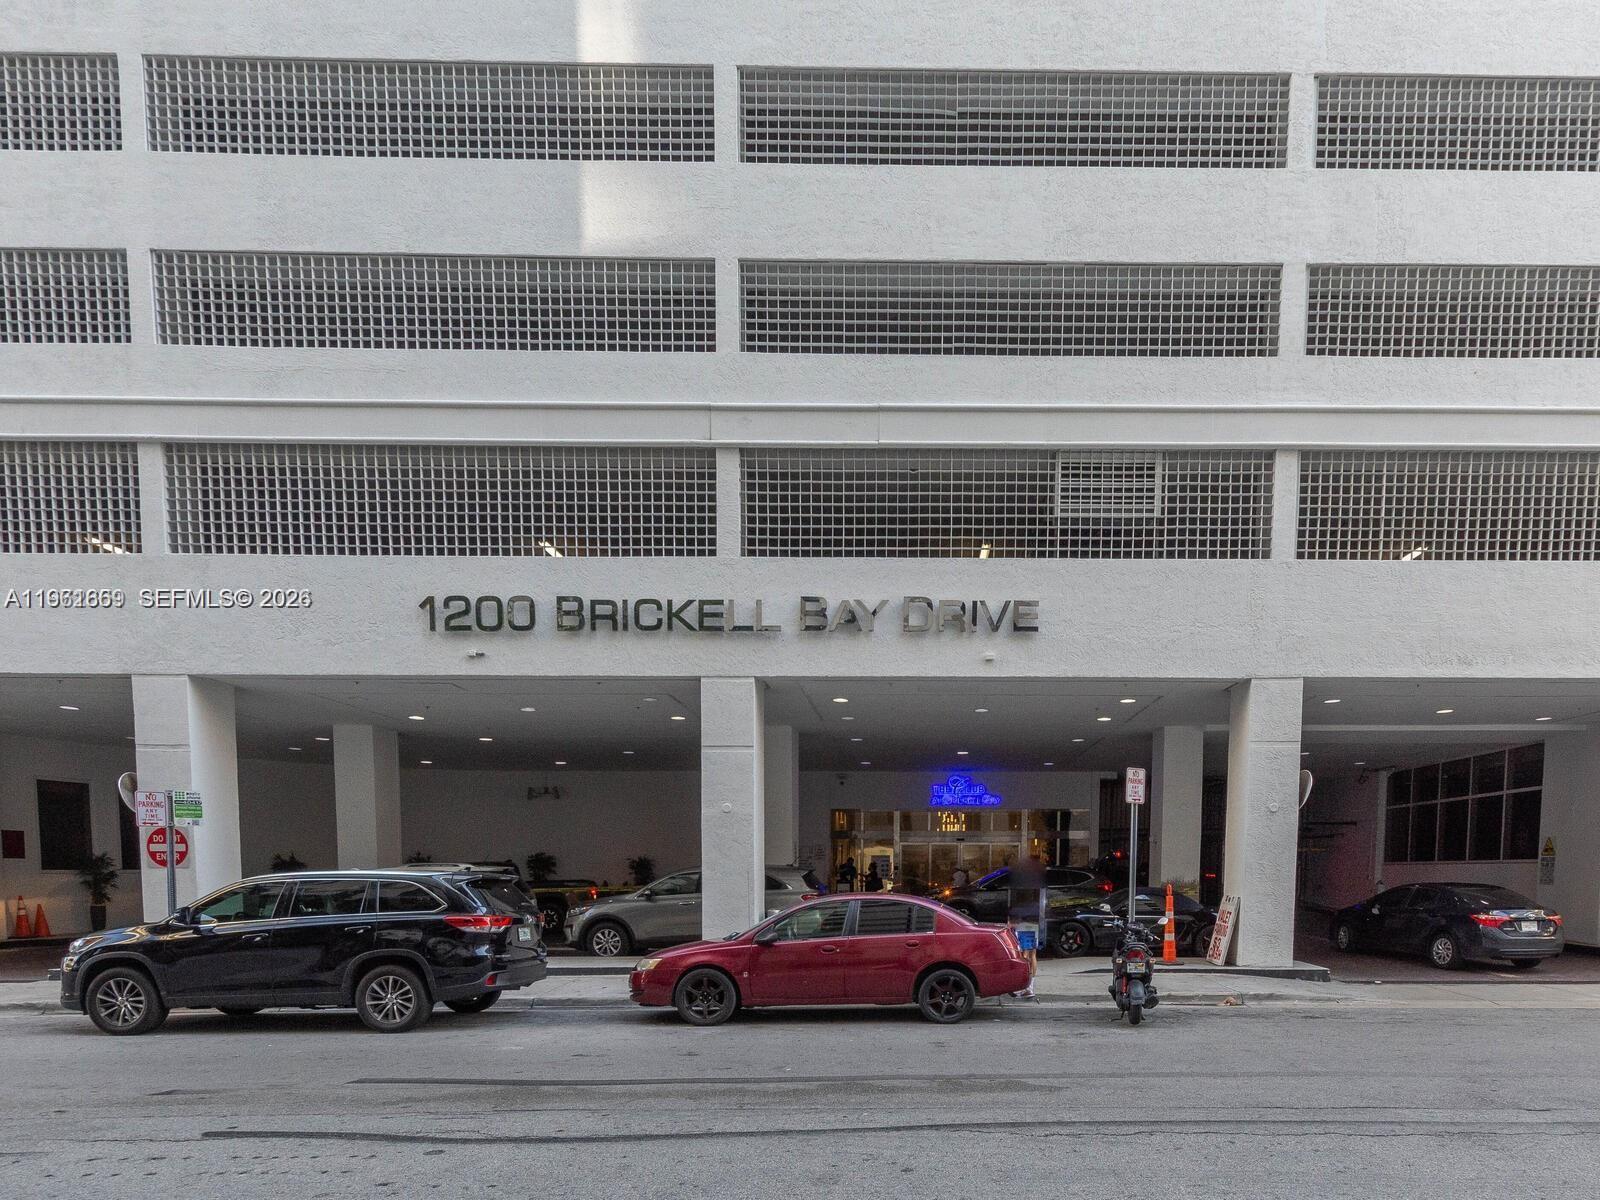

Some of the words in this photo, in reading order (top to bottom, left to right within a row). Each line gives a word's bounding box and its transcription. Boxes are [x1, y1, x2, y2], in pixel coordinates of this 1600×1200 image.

[418, 595, 536, 632] 1200
[556, 595, 782, 632] BRICKELL
[800, 595, 890, 633] BAY
[903, 595, 1040, 633] DRIVE
[145, 793, 157, 801] NO
[138, 800, 165, 809] PARKING
[153, 834, 164, 843] DO
